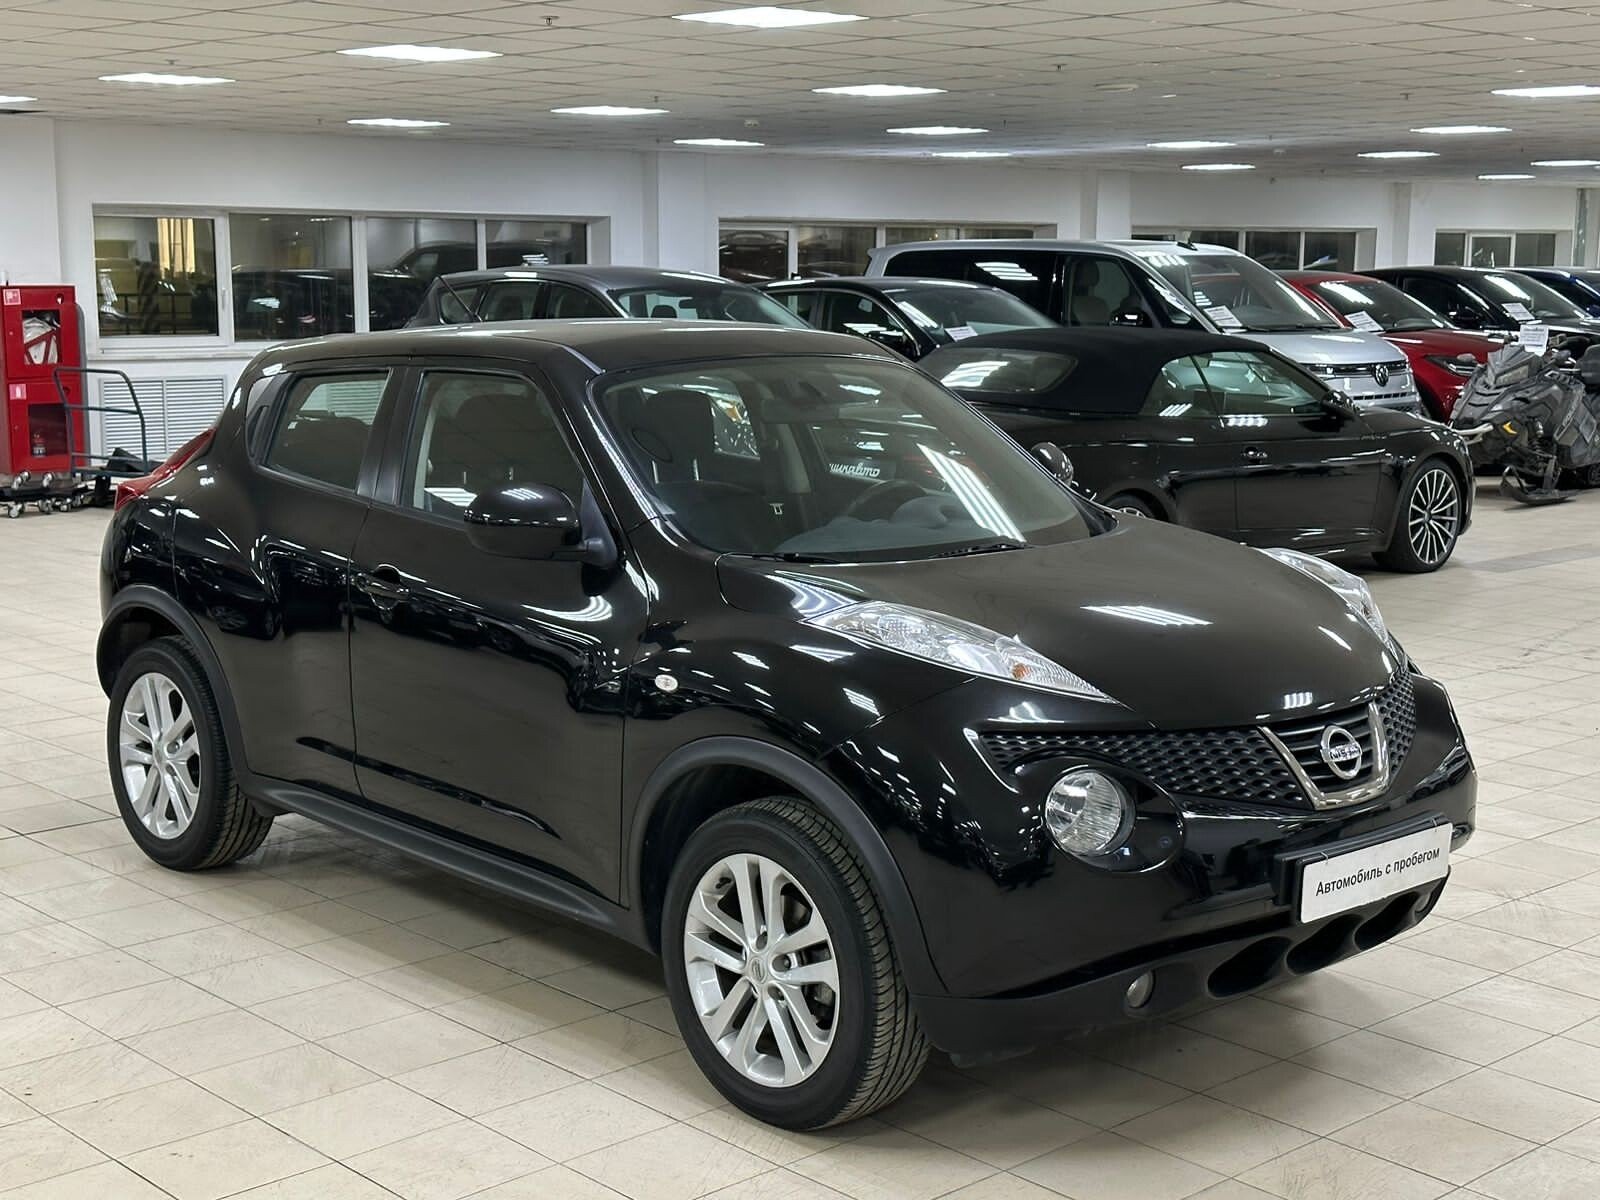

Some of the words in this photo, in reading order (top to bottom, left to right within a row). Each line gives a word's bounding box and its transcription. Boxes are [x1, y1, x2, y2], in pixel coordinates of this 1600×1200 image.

[1315, 865, 1383, 896] Автомобиль
[1385, 863, 1391, 874] с
[1393, 847, 1440, 873] пробегом
